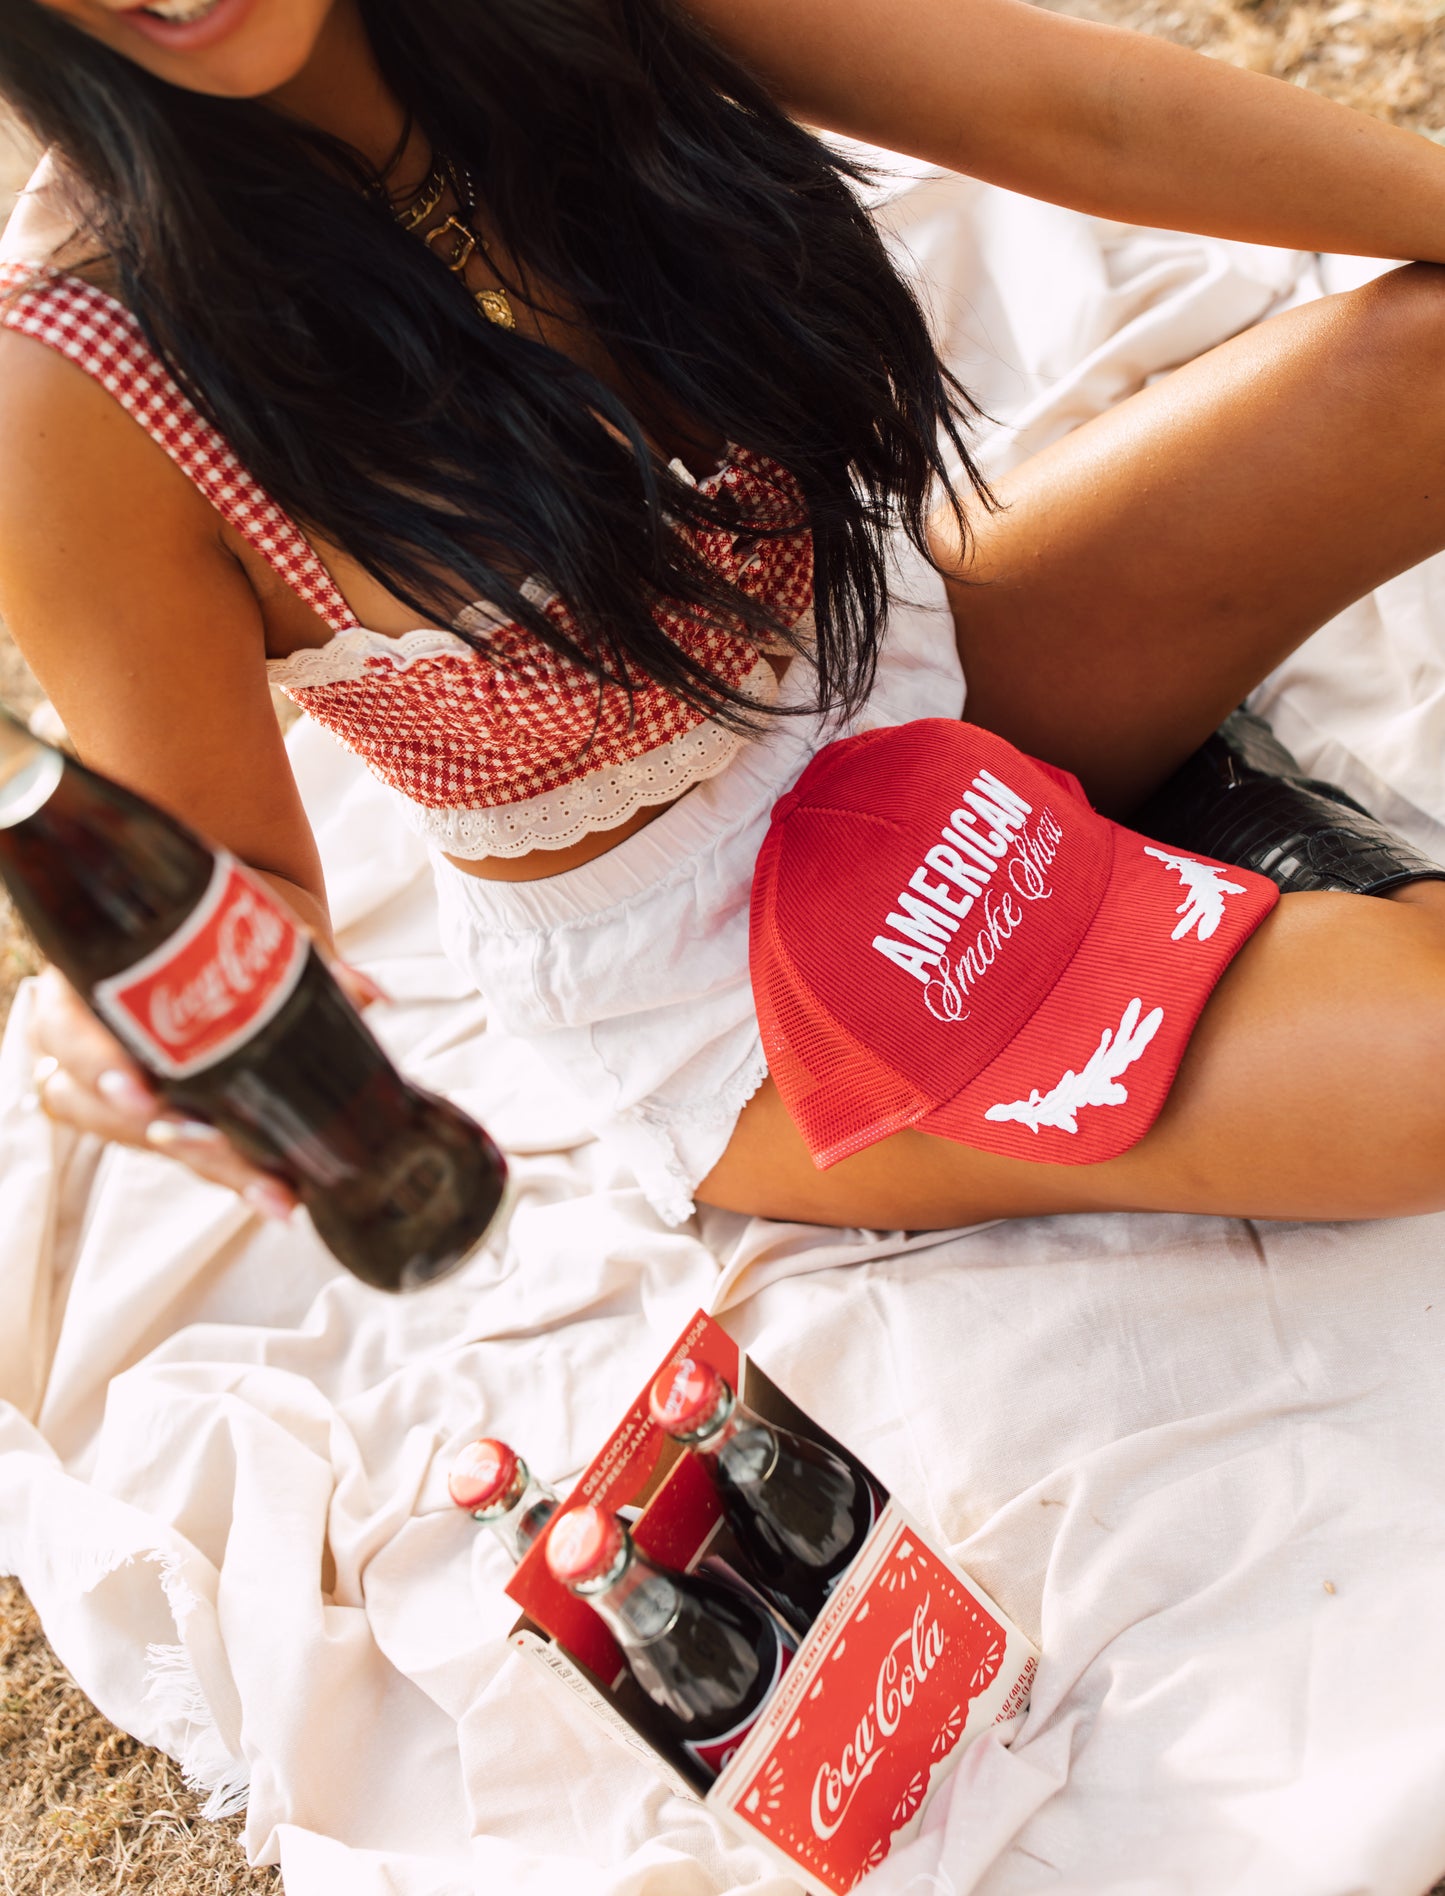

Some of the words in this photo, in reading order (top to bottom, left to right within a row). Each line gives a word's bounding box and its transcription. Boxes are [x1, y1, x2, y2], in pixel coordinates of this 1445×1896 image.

[872, 769, 1033, 985] AMERICAN
[924, 889, 1023, 1023] Smoke
[1008, 806, 1063, 900] Show
[582, 1423, 636, 1496] DELICIOSA
[633, 1408, 642, 1420] Y
[770, 1670, 804, 1727] HECHO
[803, 1646, 818, 1669] EN
[996, 1713, 1003, 1723] FL
[1002, 1699, 1011, 1712] OZ
[1009, 1683, 1021, 1700] (48
[1018, 1674, 1027, 1685] FL
[1024, 1656, 1036, 1674] OZ)
